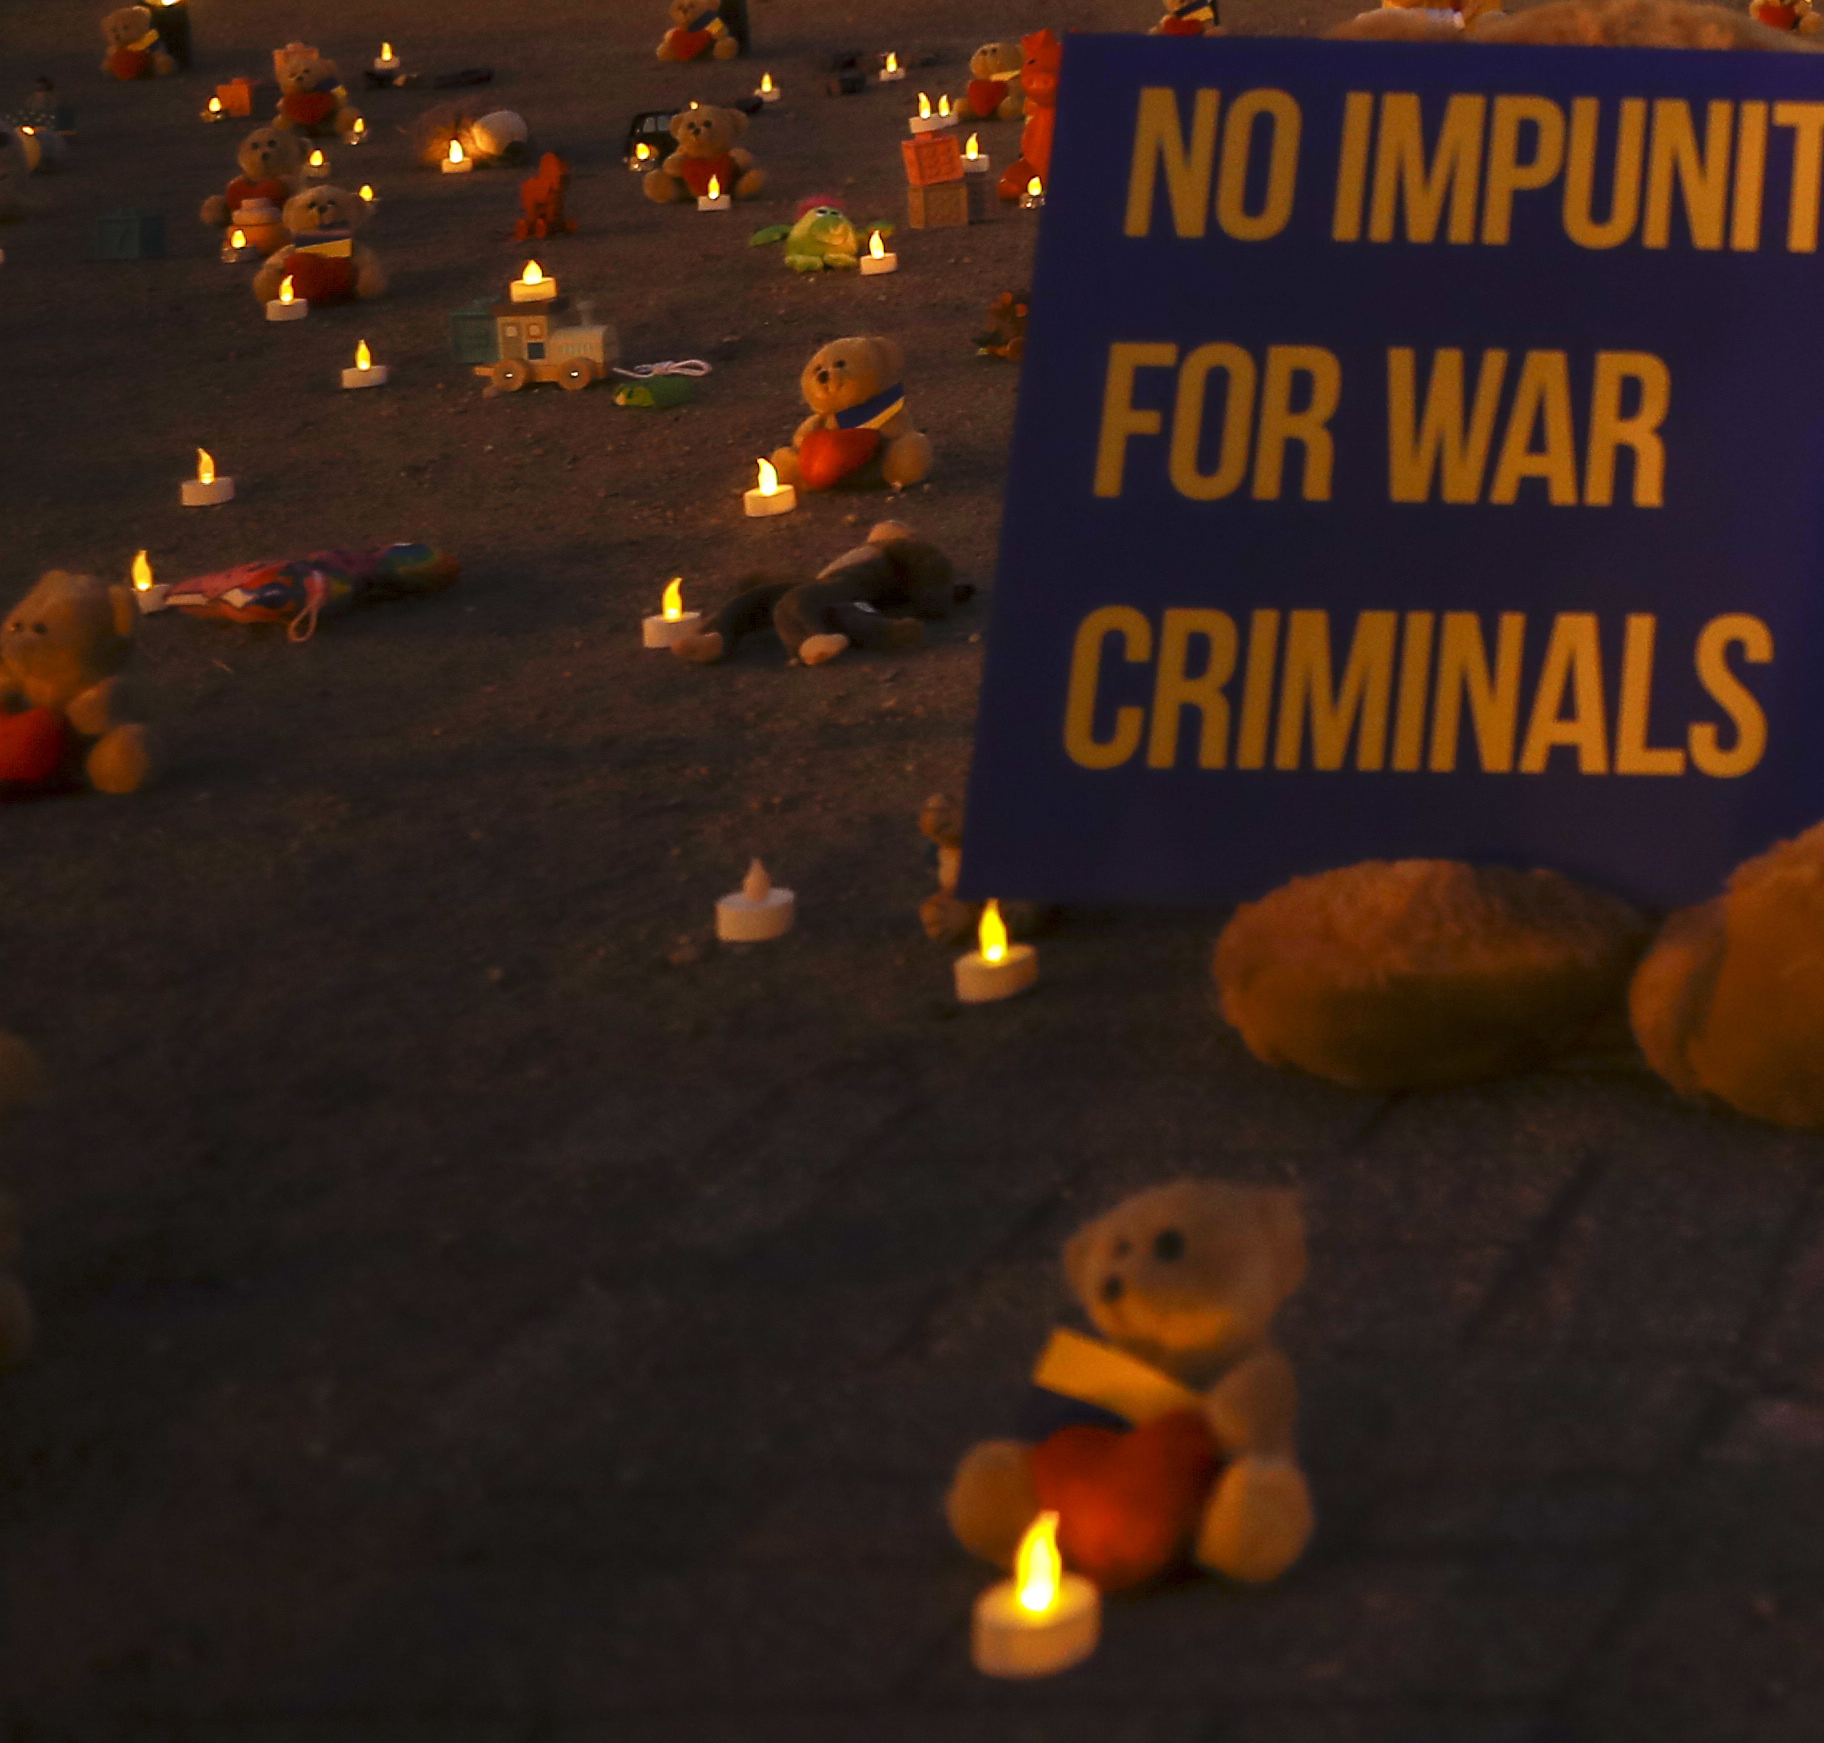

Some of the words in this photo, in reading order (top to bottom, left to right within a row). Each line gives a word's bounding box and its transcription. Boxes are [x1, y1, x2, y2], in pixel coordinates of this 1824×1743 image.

[1122, 86, 1303, 242] NO
[1092, 340, 1343, 501] FOR
[1386, 346, 1672, 508] WAR
[1061, 604, 1775, 778] CRIMINALS
